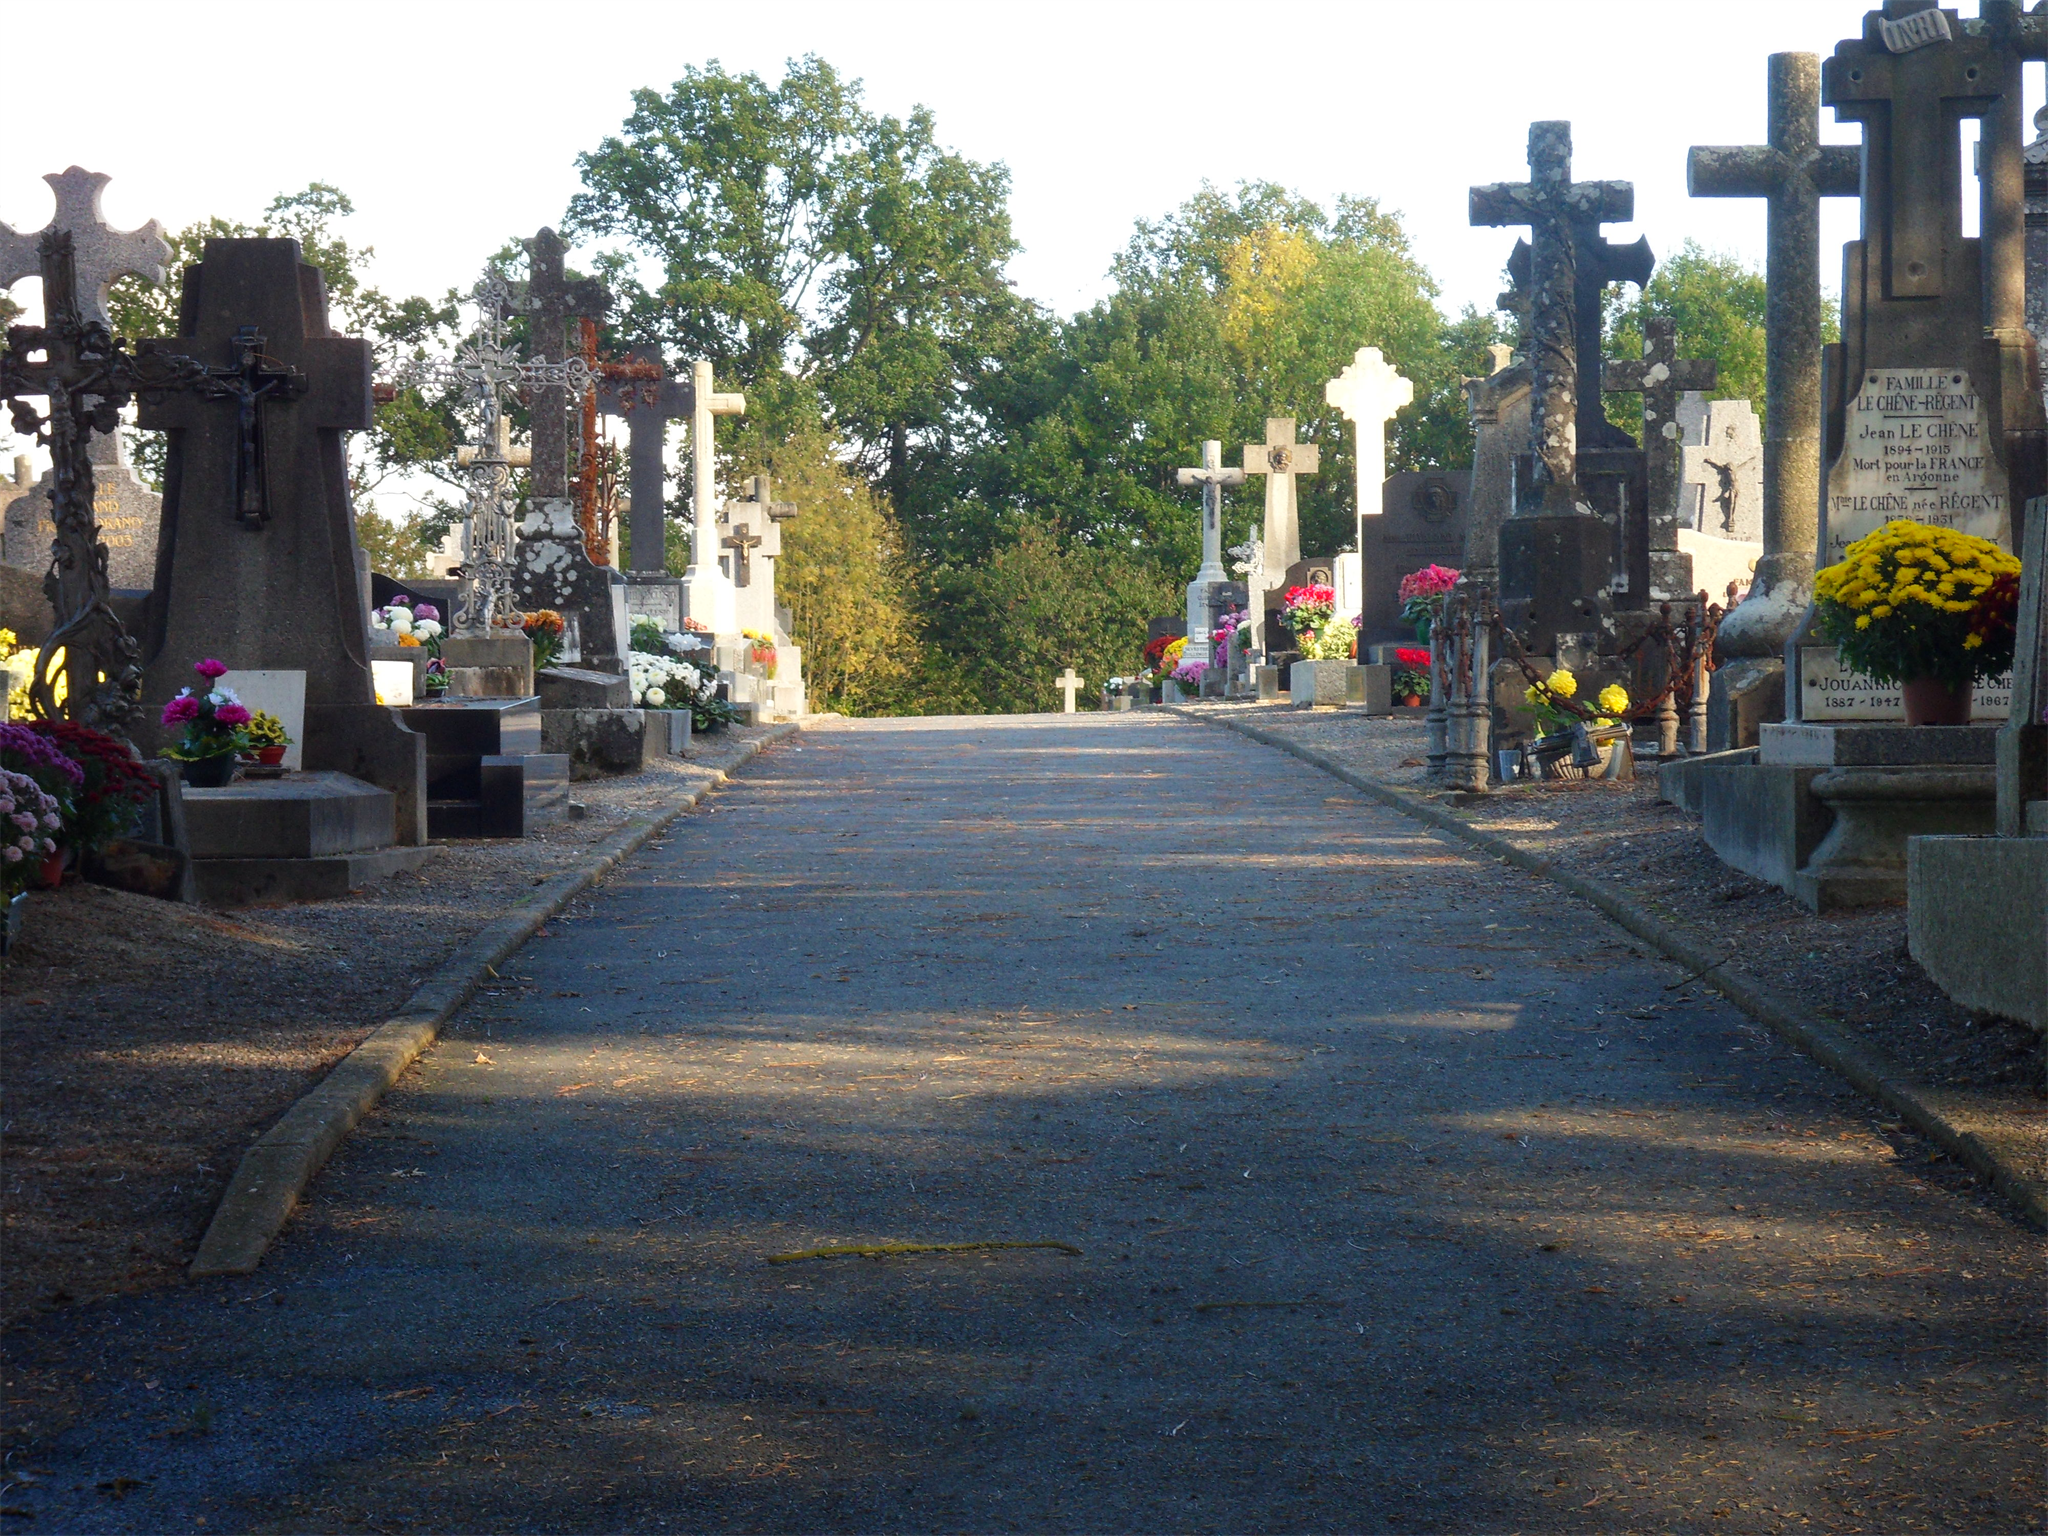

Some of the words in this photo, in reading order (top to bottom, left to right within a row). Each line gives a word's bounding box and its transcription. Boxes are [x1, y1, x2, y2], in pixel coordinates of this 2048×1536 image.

[1886, 10, 1945, 50] INRI
[1886, 375, 1947, 391] FAMILLE
[1857, 396, 1873, 411] LE
[1859, 425, 1895, 438] Jean
[1900, 425, 1921, 438] LE
[1926, 421, 1979, 438] CHÊNE
[1853, 458, 1880, 471] Mort
[1885, 460, 1914, 472] pour
[1915, 458, 1927, 470] la
[1930, 457, 1985, 470] FRANCE
[1887, 473, 1900, 482] en
[1904, 472, 1959, 486] Argonne
[1854, 497, 1869, 510] LE
[1870, 493, 1908, 511] CHÊNE
[1913, 499, 1936, 510] née
